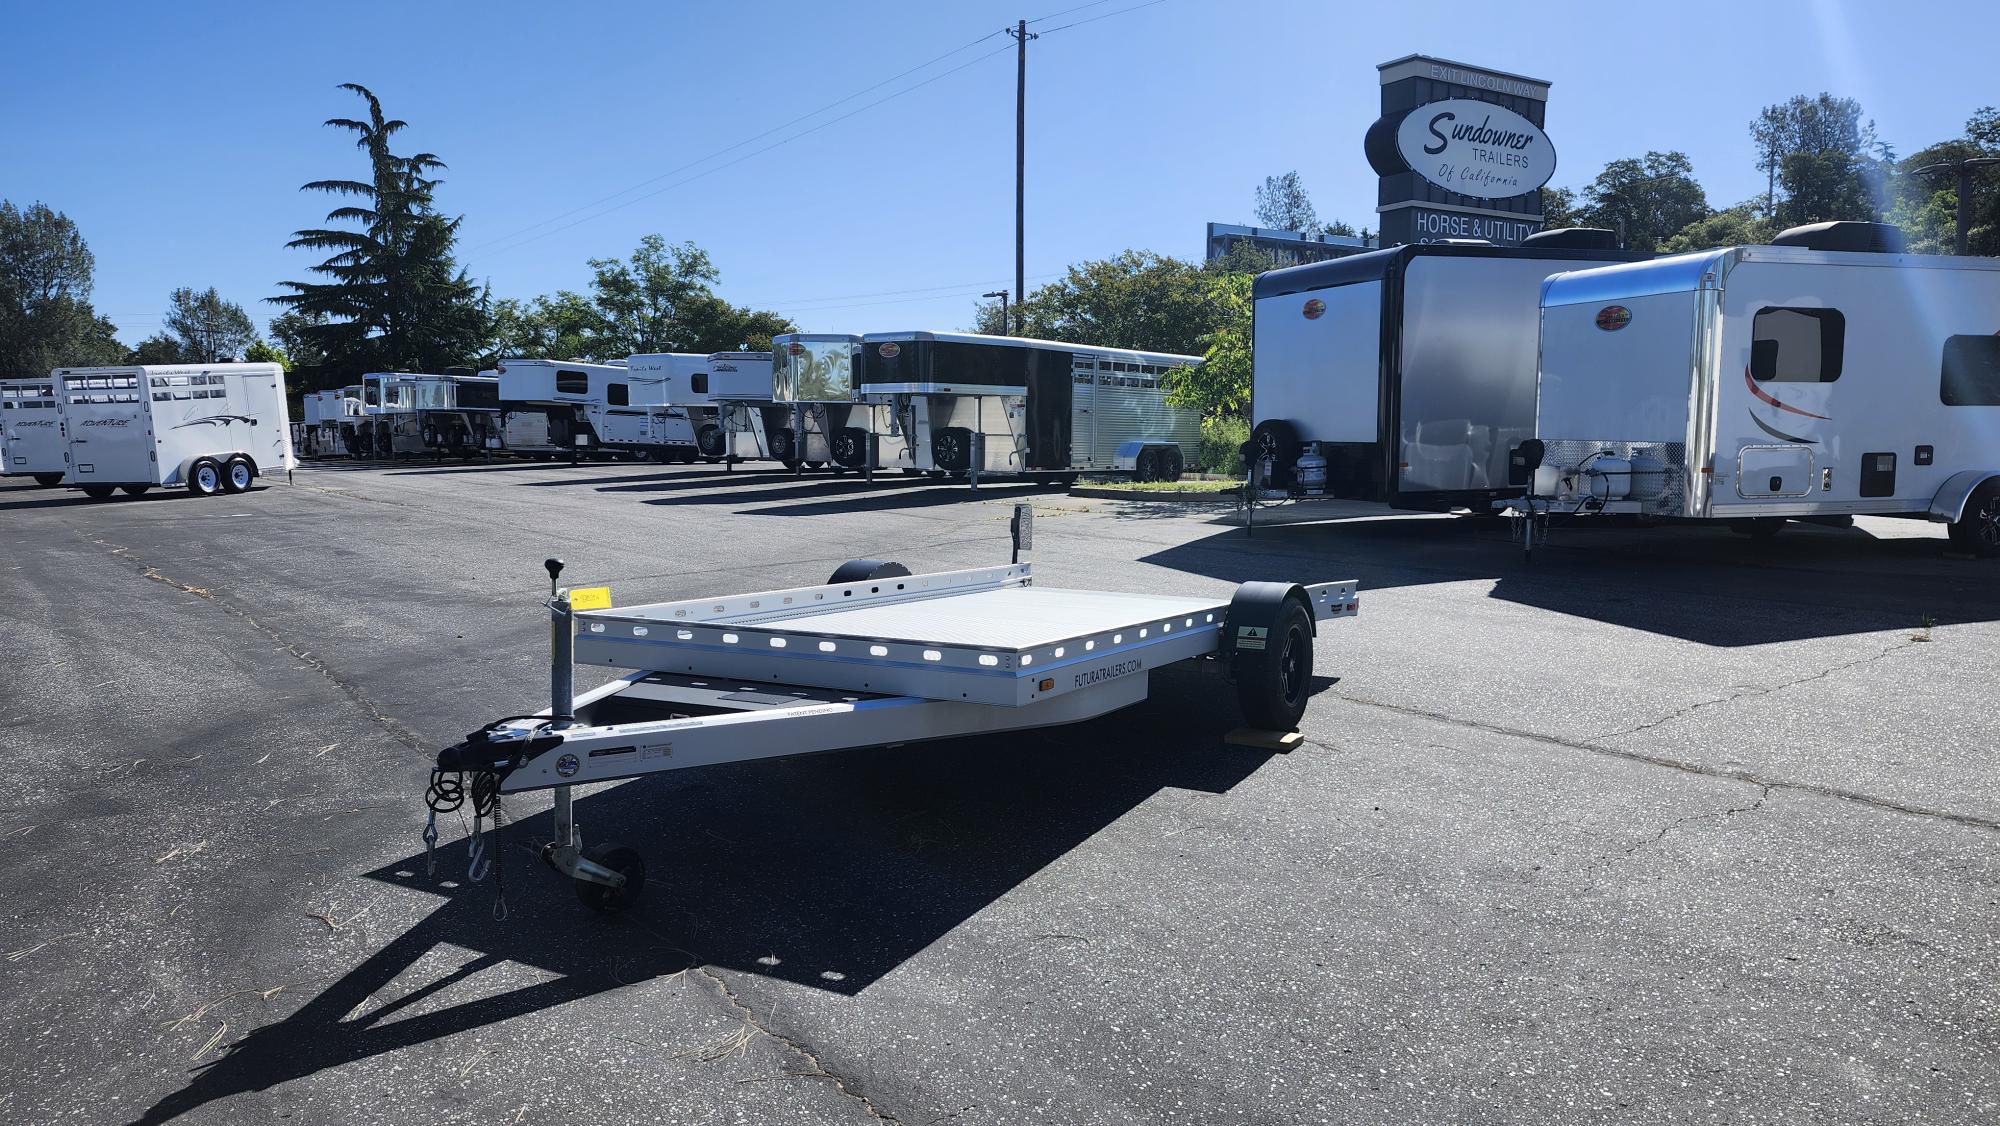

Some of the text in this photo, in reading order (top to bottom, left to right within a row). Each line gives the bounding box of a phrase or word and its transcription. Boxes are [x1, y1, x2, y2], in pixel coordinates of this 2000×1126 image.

[1431, 64, 1537, 97] EXIT LINCOLN WAY
[1423, 112, 1534, 154] Sundowner
[1472, 147, 1529, 169] TRAILERS
[1438, 163, 1518, 187] Of California
[1417, 212, 1534, 241] HORSE & UTILITY
[1074, 657, 1142, 688] FUTURATRAILERS.COM
